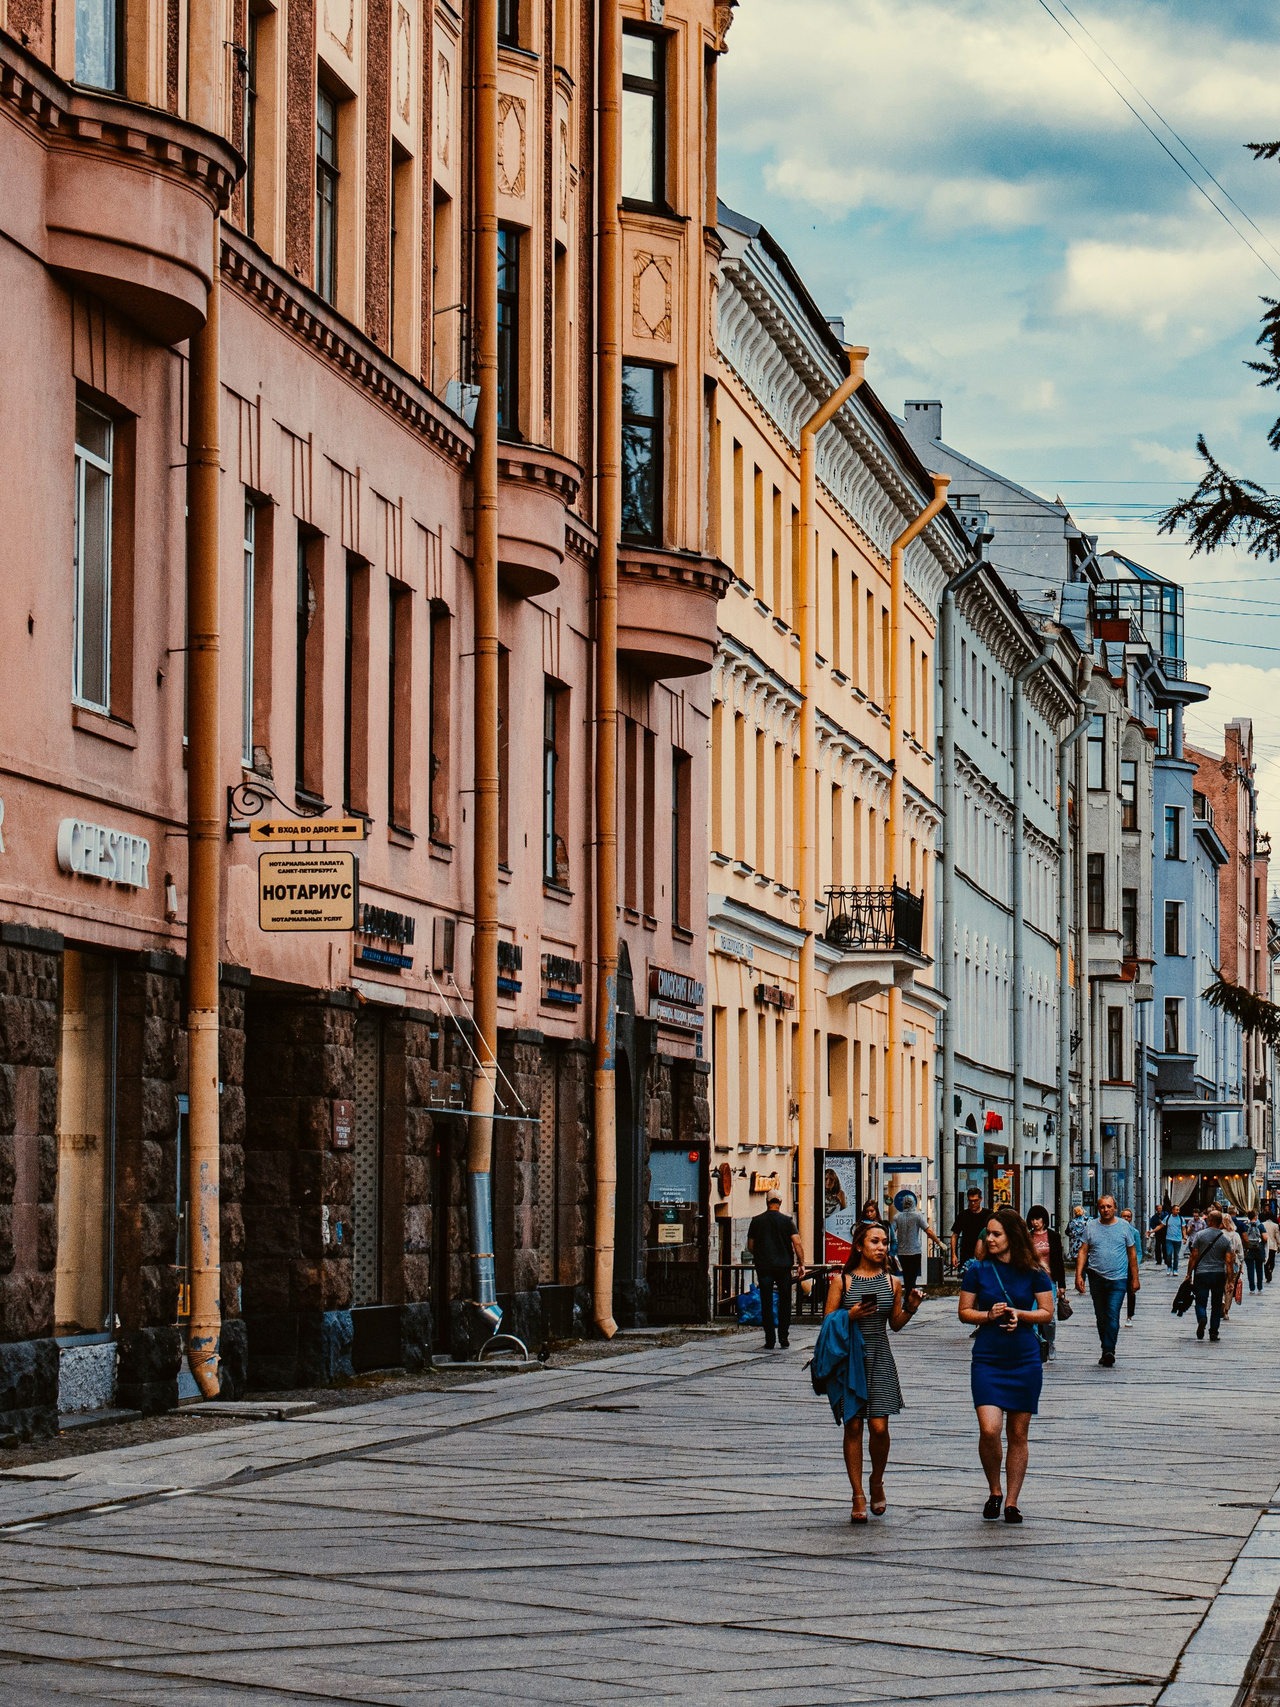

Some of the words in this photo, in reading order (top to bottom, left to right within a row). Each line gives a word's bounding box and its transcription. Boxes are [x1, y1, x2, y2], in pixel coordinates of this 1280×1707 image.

[278, 826, 299, 834] ВХОД
[58, 818, 150, 889] CHESTER
[263, 883, 352, 900] НОТАРИУС
